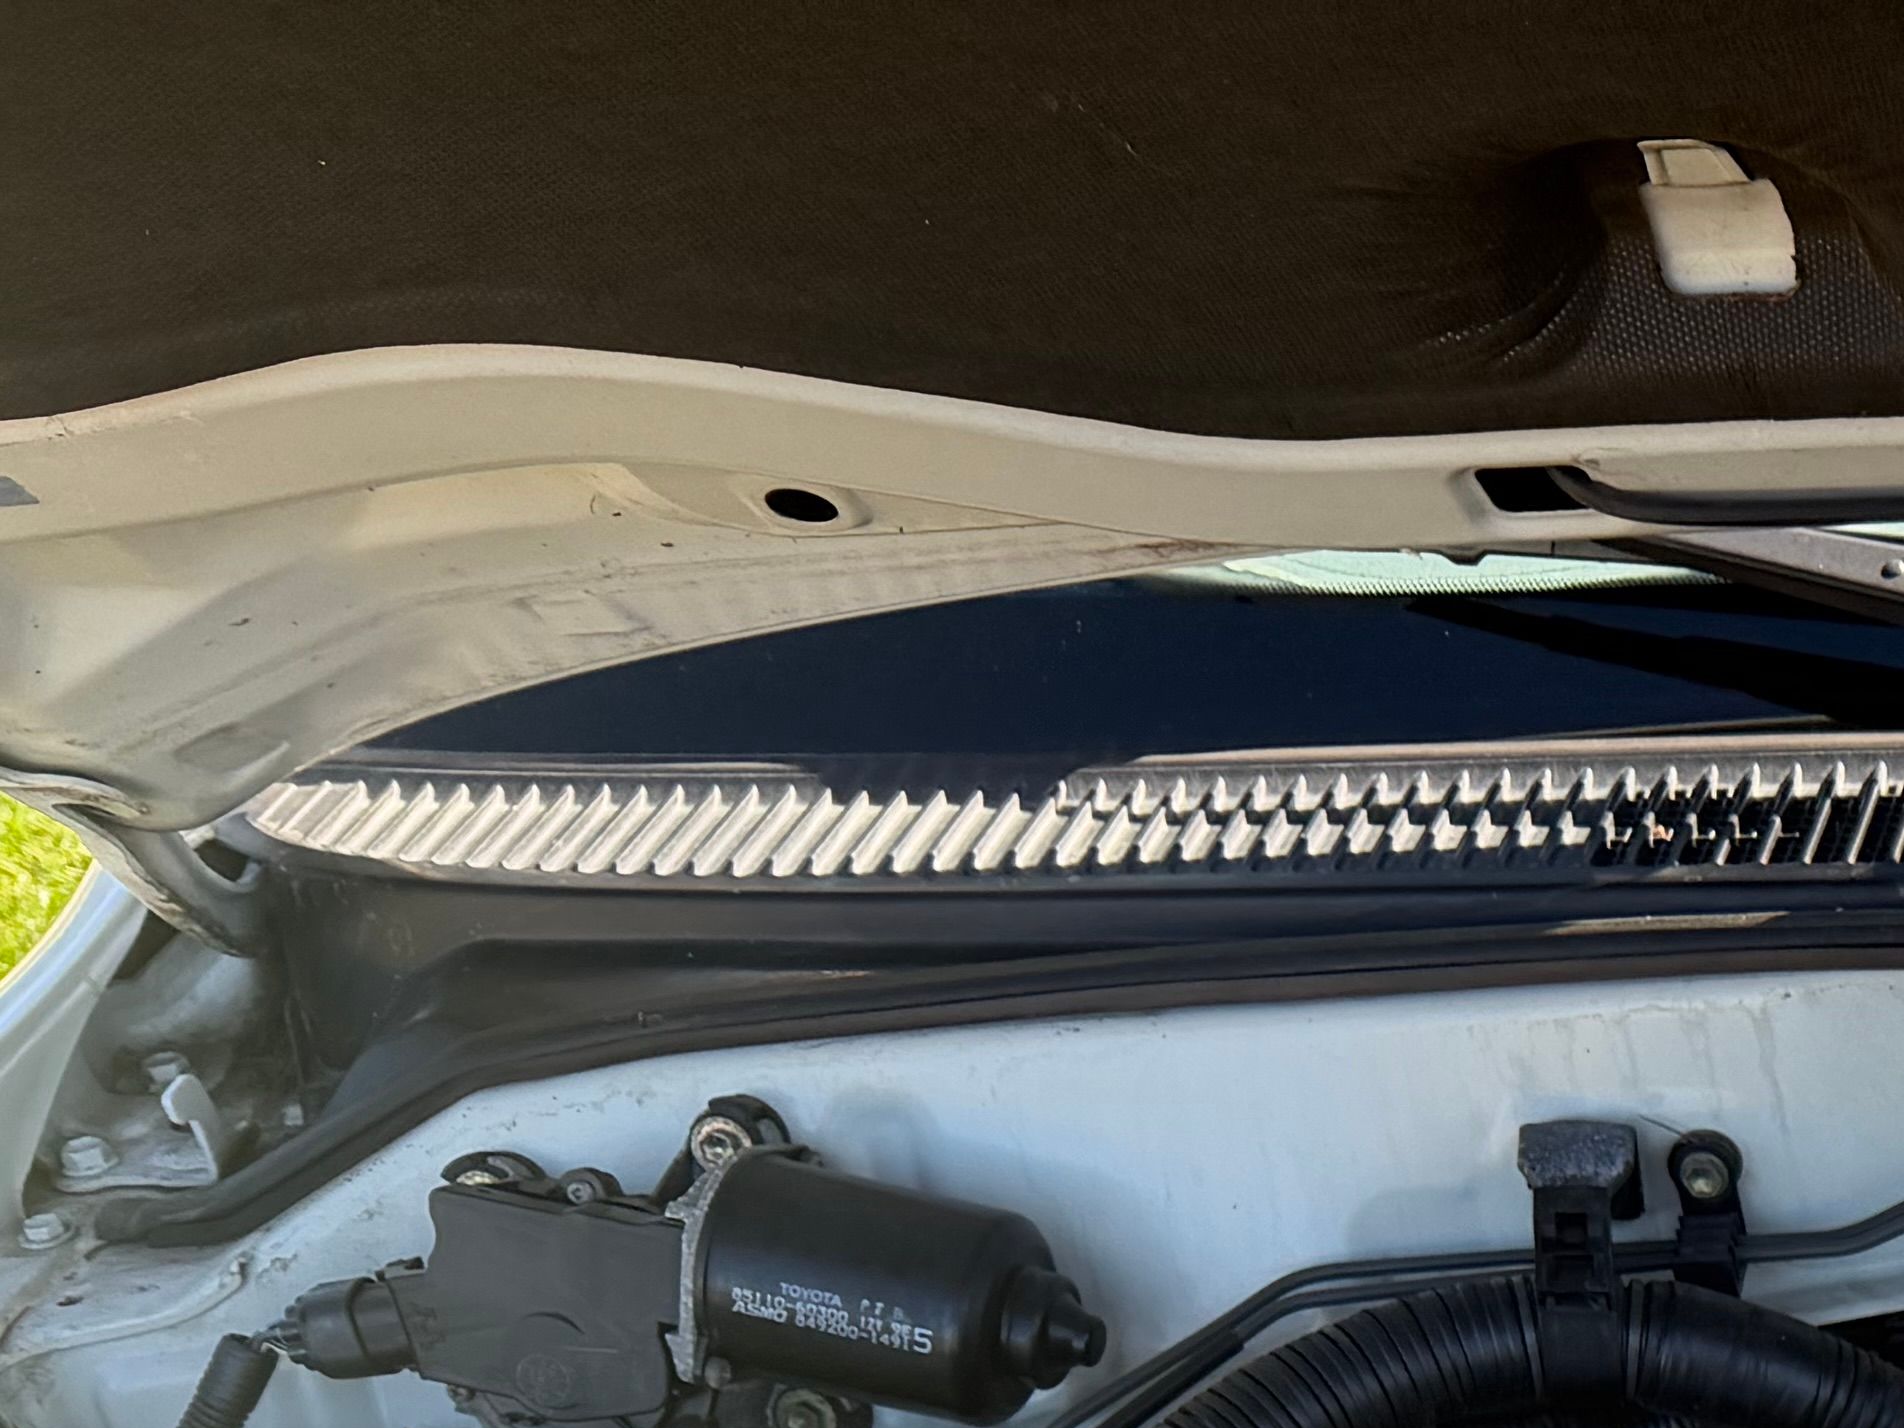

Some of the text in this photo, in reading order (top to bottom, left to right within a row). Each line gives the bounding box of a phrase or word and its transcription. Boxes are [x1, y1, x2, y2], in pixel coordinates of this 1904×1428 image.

[731, 1286, 849, 1326] 85110-60300
[780, 1282, 843, 1309] TOYOTA
[731, 1301, 788, 1323] ASMO
[913, 1326, 934, 1355] 5
